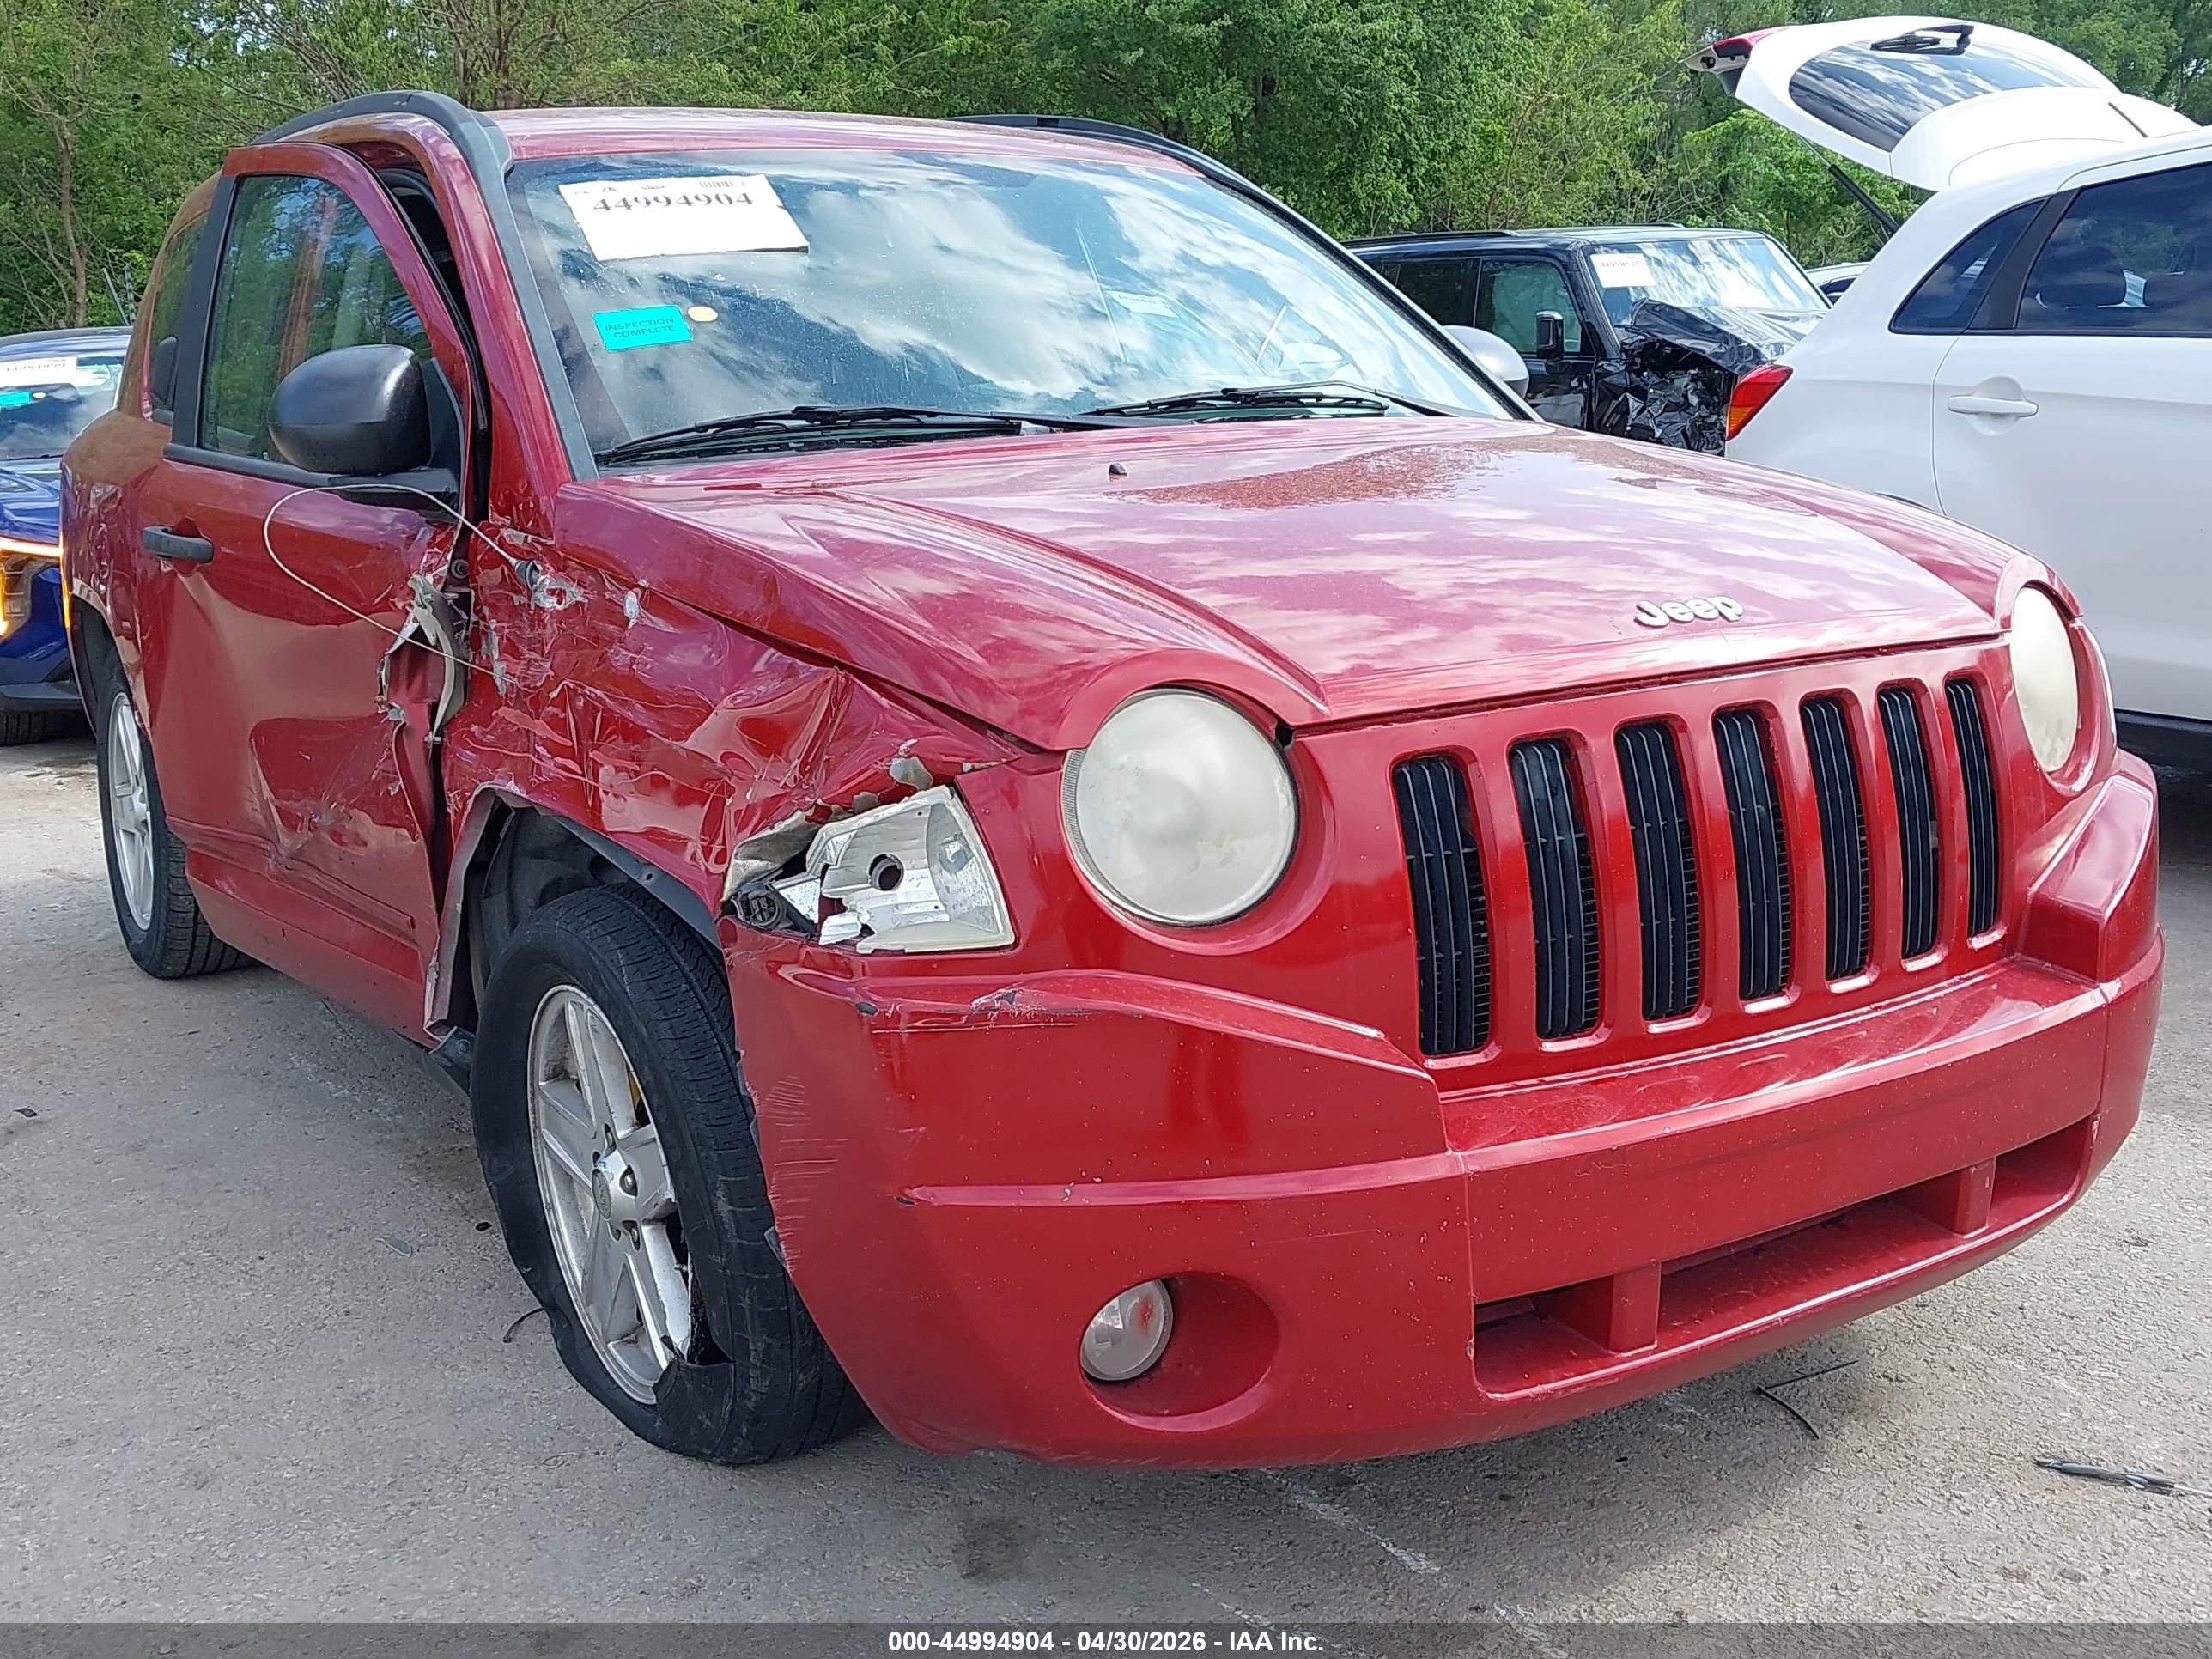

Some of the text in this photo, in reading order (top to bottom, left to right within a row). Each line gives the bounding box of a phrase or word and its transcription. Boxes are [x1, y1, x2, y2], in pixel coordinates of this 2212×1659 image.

[593, 192, 753, 211] 44994904
[605, 317, 674, 331] INSPECTION
[613, 325, 675, 338] COMPLETE
[1633, 595, 1744, 628] Jeep
